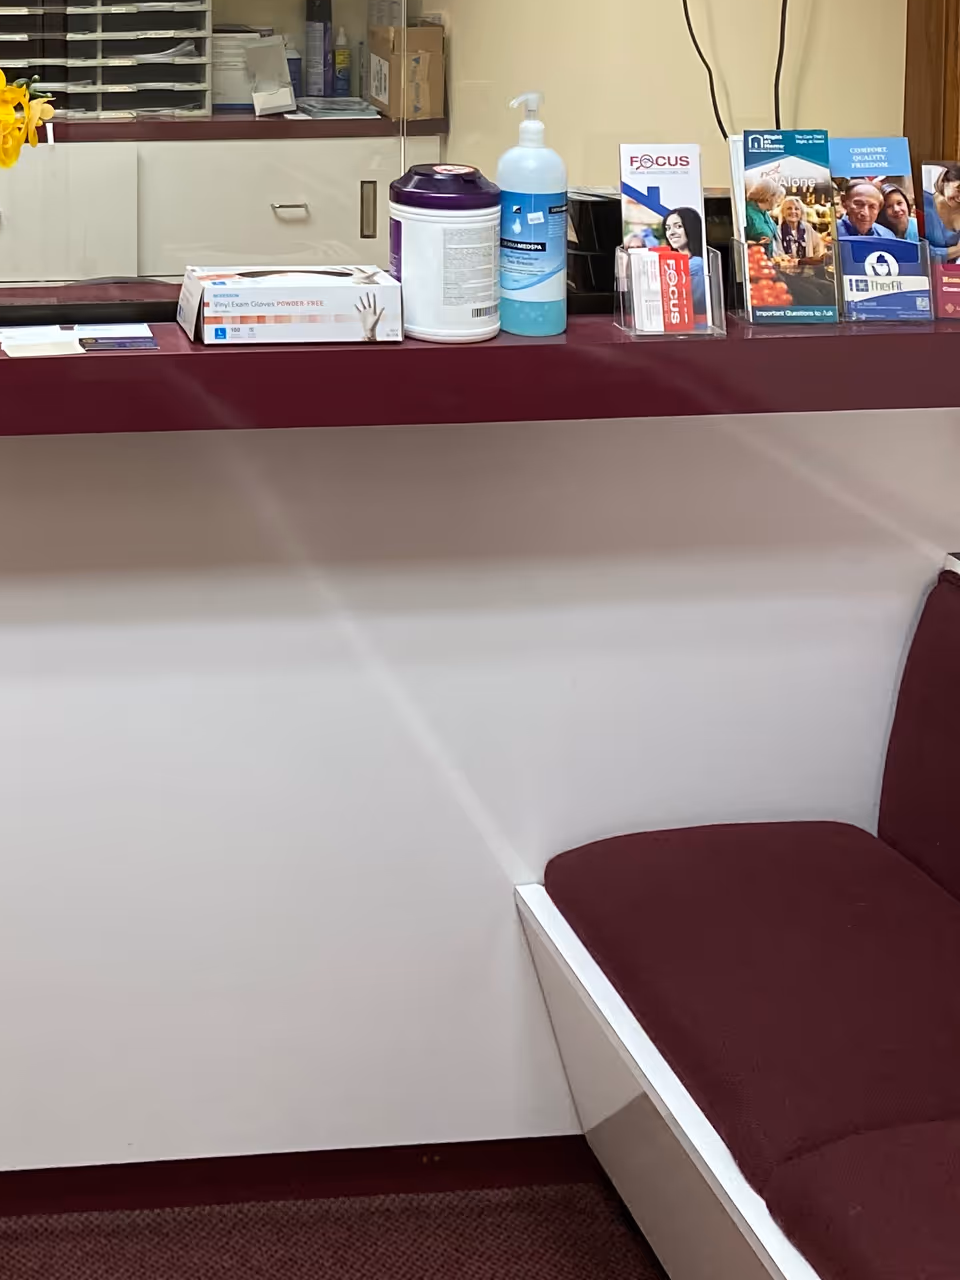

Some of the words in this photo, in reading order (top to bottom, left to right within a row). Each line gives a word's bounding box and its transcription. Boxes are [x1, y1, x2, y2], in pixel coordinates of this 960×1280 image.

[630, 154, 690, 170] FOCUS
[779, 176, 816, 188] Alone
[664, 260, 680, 324] FOCUS
[214, 301, 230, 309] Vinyl
[251, 300, 275, 308] Gloves
[756, 310, 784, 318] Important
